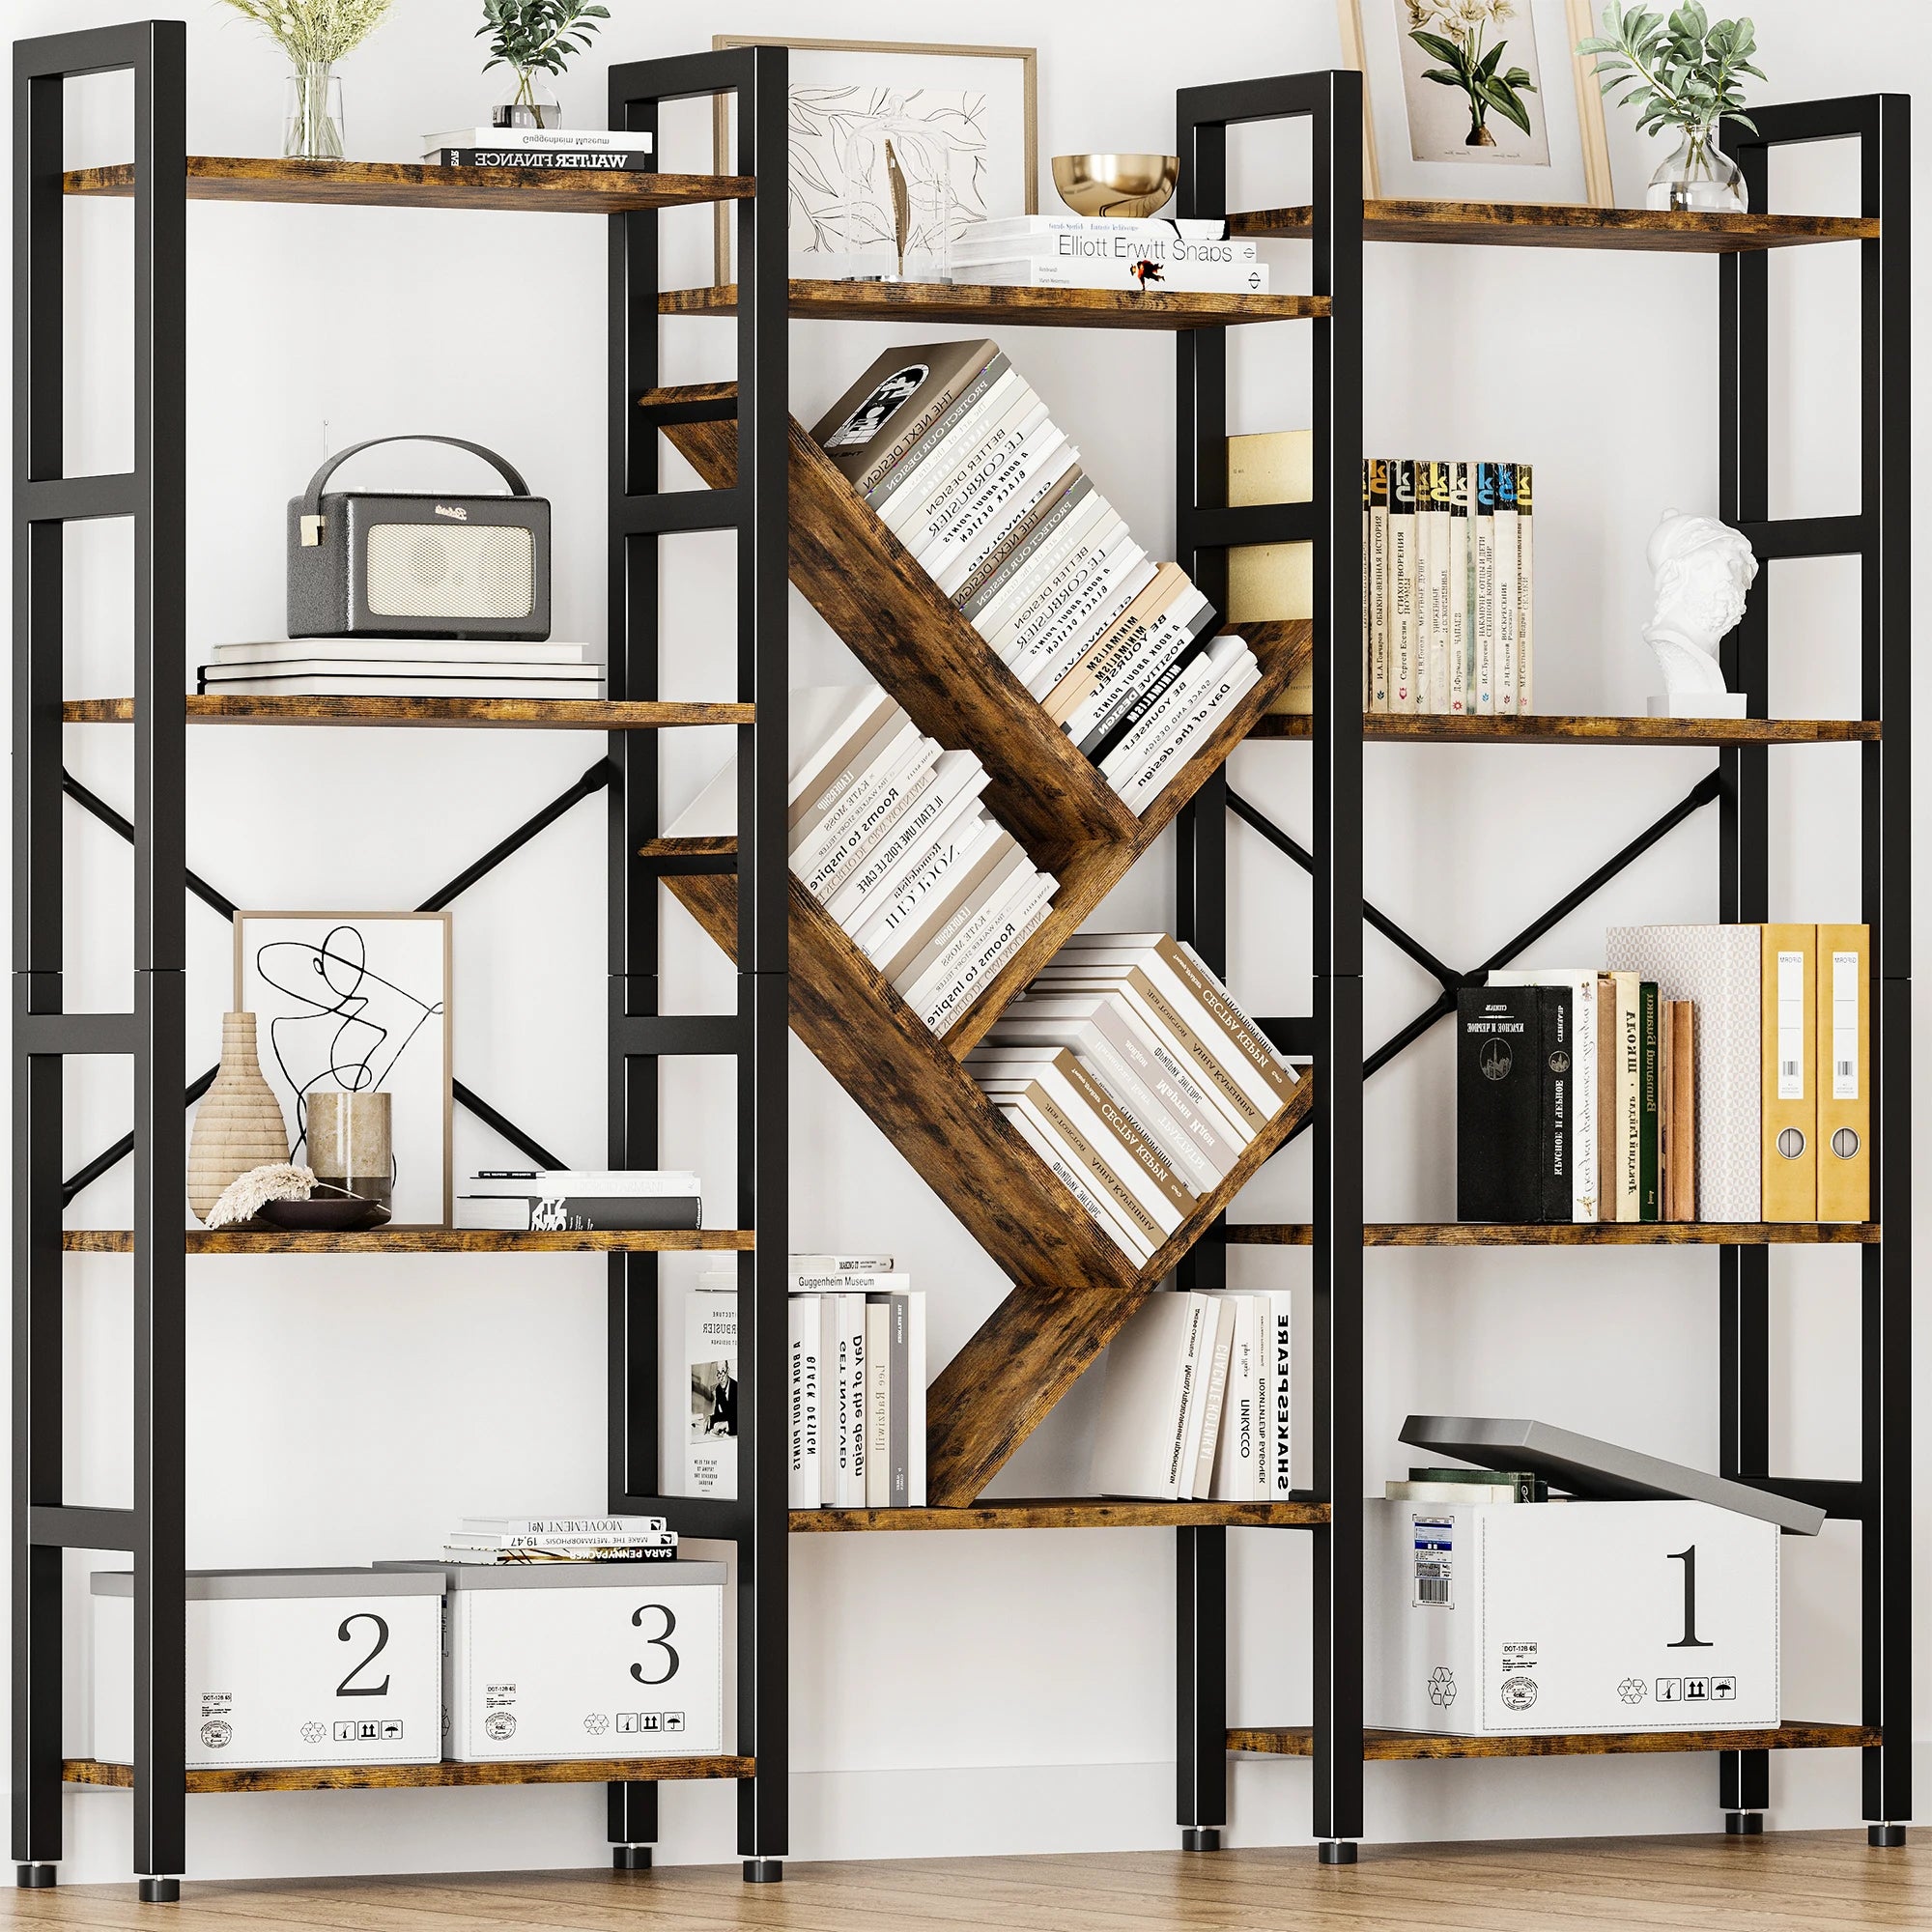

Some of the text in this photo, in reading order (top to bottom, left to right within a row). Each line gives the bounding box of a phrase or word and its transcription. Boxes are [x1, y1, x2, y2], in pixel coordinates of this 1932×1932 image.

[1060, 235, 1233, 263] Elliott Erwitt Snaps
[798, 1277, 875, 1287] Guggenheim Museum
[547, 1520, 622, 1532] MOOVEMENT
[570, 1548, 672, 1560] SARA PENNYPACKER
[1667, 1545, 1714, 1648] 1
[336, 1613, 390, 1696] 2
[630, 1604, 680, 1685] 3
